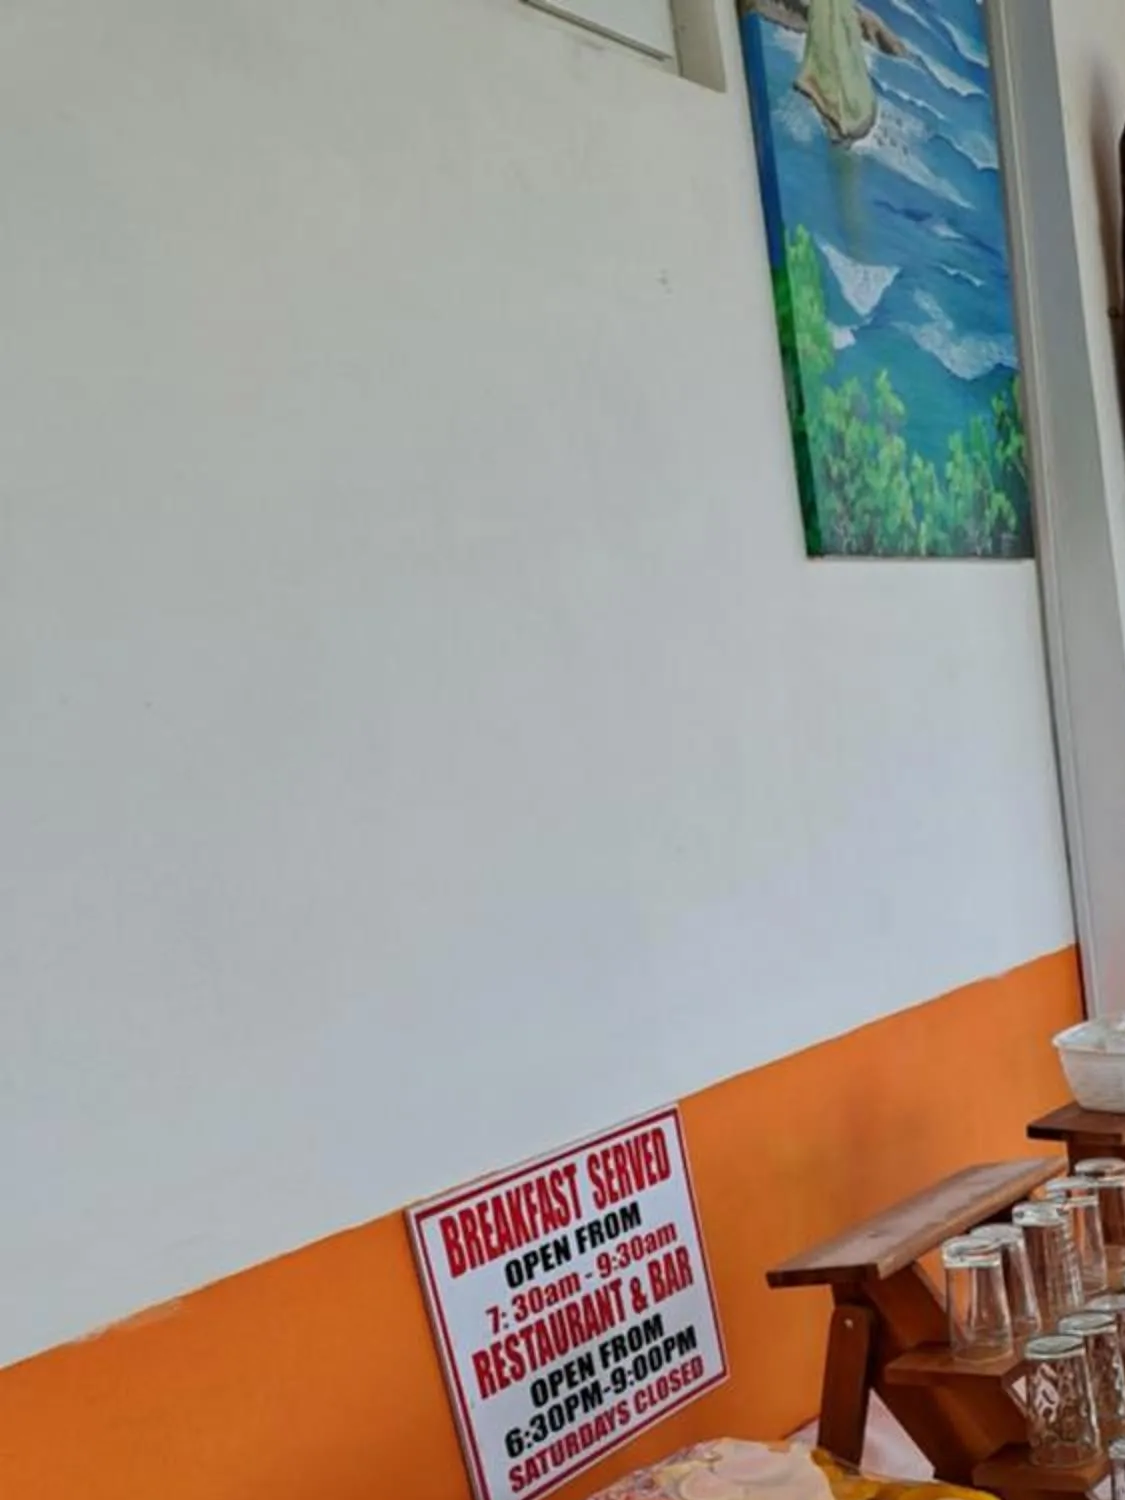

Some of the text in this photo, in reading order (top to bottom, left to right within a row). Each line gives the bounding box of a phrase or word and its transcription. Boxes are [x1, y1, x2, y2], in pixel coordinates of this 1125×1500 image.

[439, 1127, 671, 1278] BREAKFAST SERVED
[505, 1202, 642, 1289] OPEN FROM
[595, 1223, 678, 1278] 9:30am
[472, 1246, 694, 1399] RESTAURANT & BAR
[529, 1314, 665, 1408] OPEN FROM
[509, 1354, 704, 1493] SATURDAYS CLOSED
